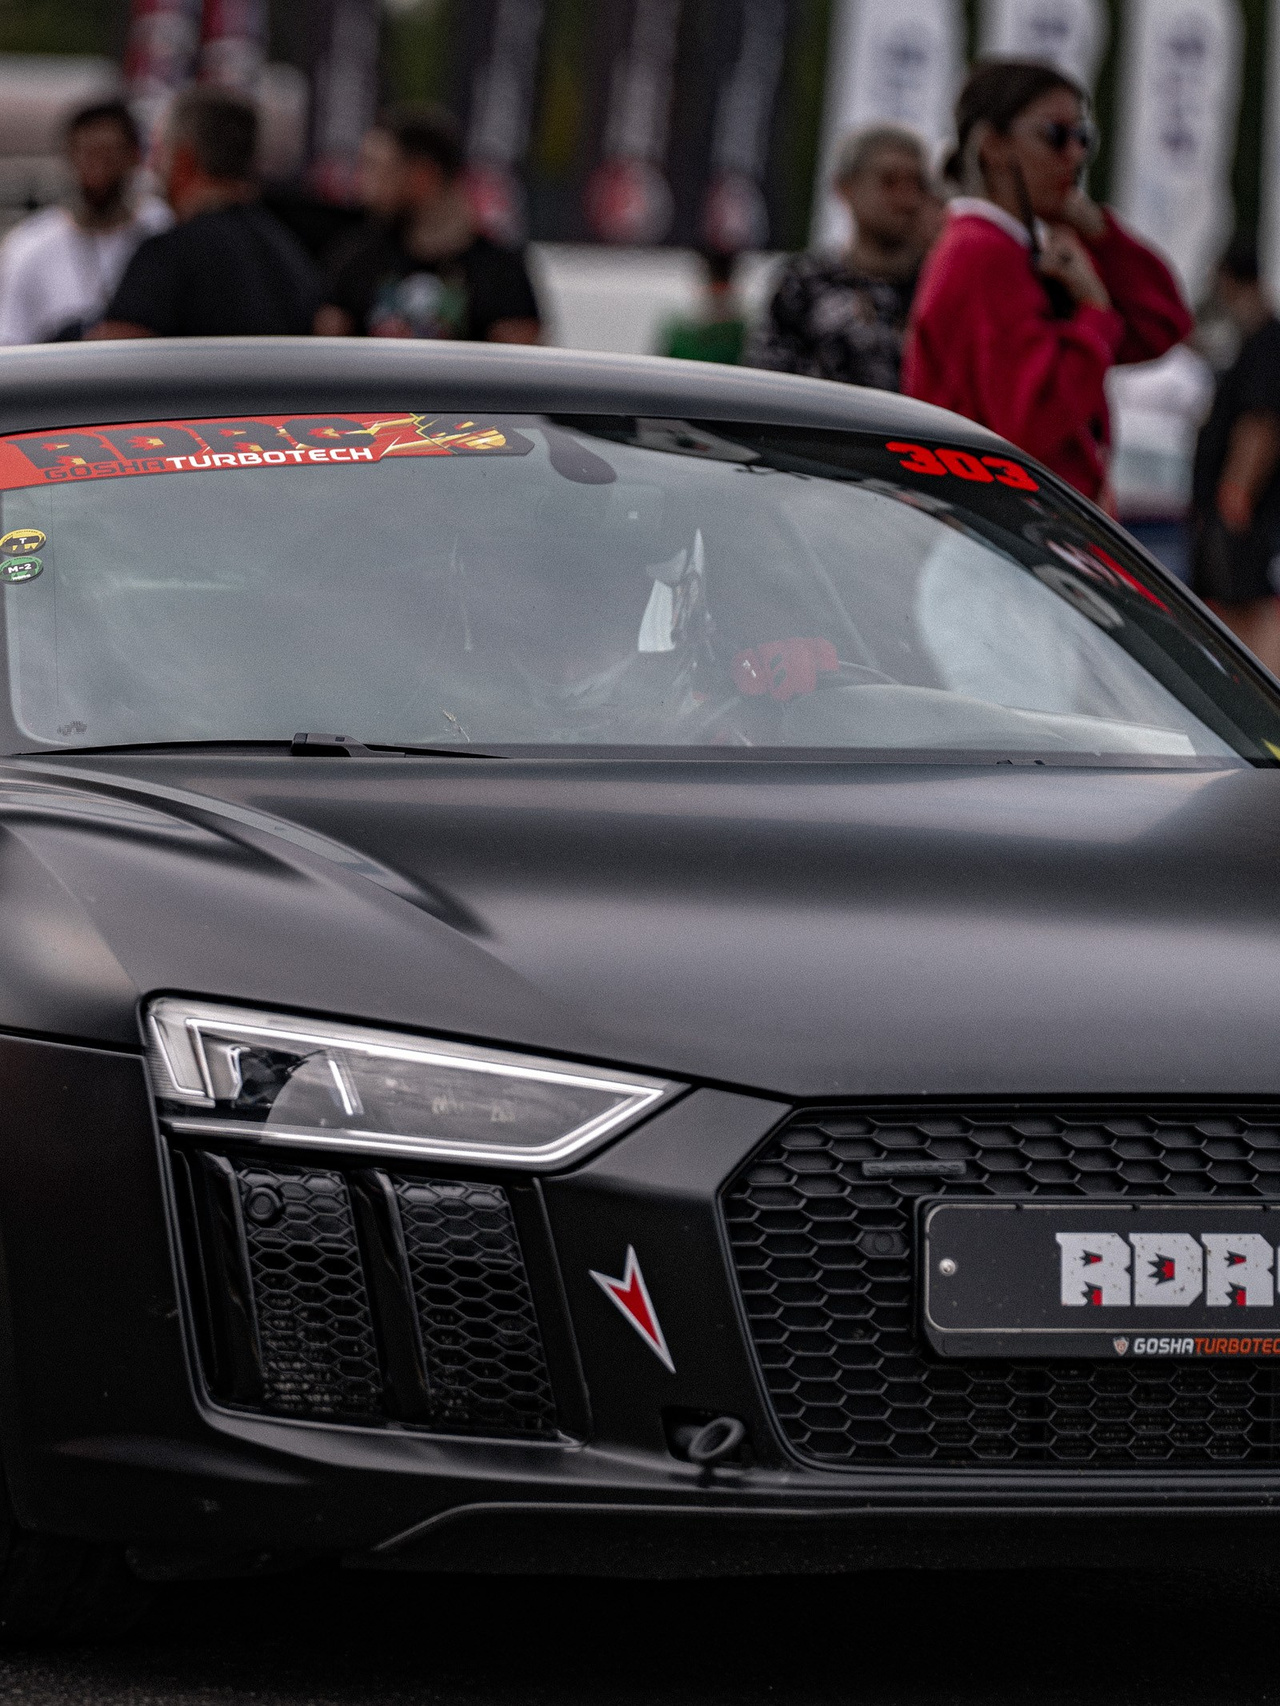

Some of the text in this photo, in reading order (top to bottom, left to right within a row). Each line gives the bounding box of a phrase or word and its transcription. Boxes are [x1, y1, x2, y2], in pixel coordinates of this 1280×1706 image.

[885, 441, 1039, 491] 303
[7, 563, 32, 574] M-2
[1055, 1232, 1280, 1307] RDR
